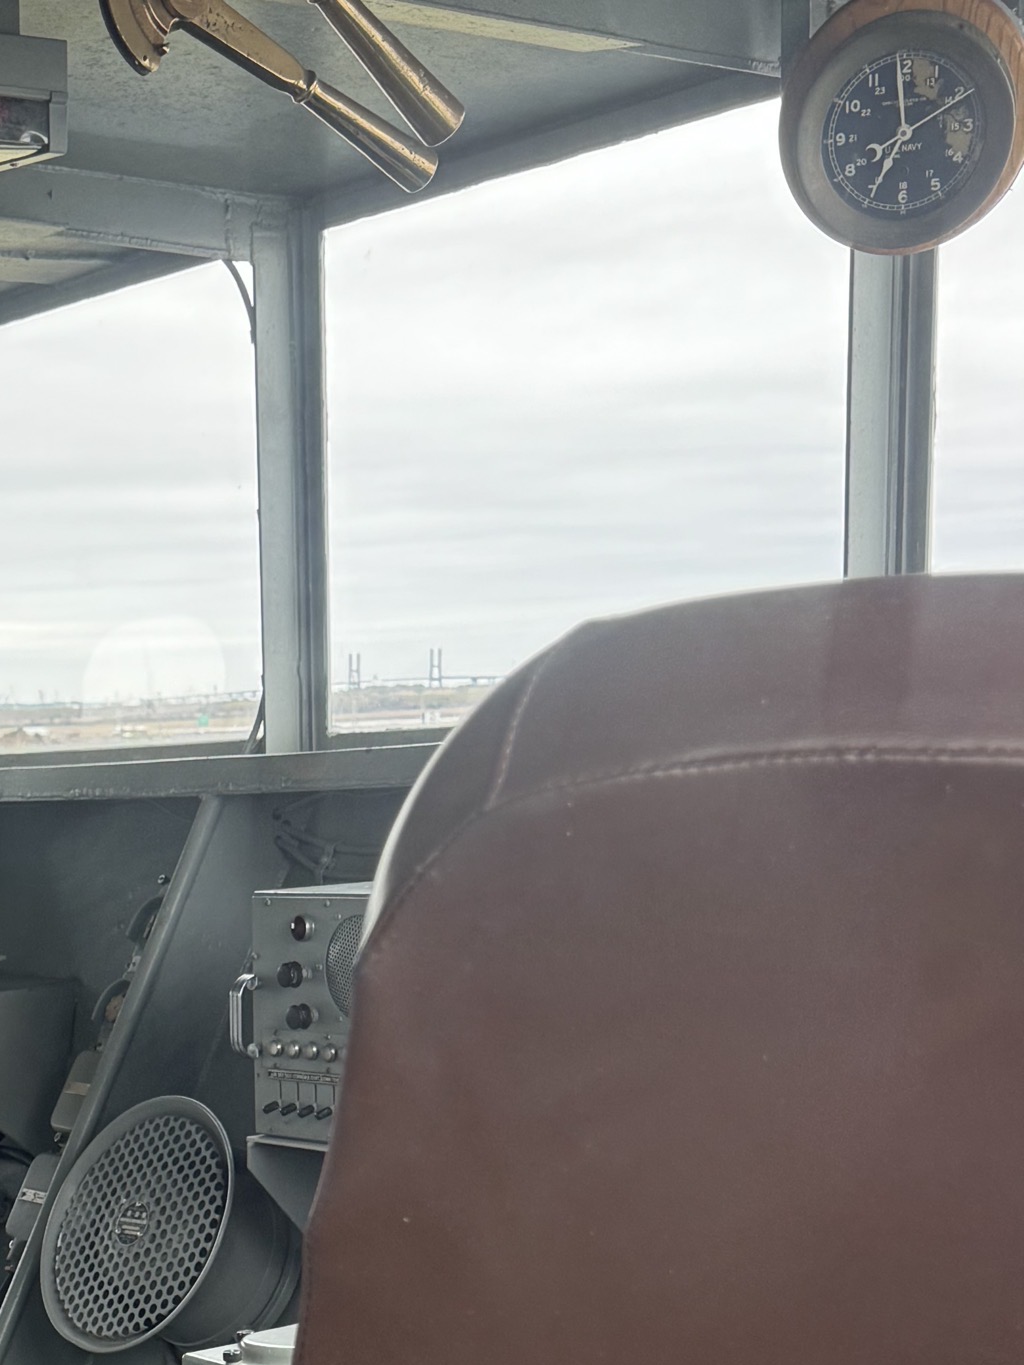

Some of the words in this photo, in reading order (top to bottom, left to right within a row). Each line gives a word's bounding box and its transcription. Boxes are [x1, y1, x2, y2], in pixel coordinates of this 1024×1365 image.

[868, 73, 879, 88] 11
[926, 78, 935, 86] 13
[874, 87, 886, 95] 23
[954, 86, 965, 99] 2
[845, 99, 860, 114] 10
[861, 109, 871, 117] 22
[951, 122, 960, 131] 15
[963, 118, 973, 132] 3
[836, 132, 845, 146] 9
[848, 134, 857, 143] 21
[901, 142, 922, 152] NAVY
[945, 149, 954, 157] 16
[952, 151, 964, 164] 4
[856, 158, 867, 166] 20
[845, 163, 856, 177] 8
[925, 169, 934, 178] 17
[899, 181, 907, 189] 18
[930, 177, 941, 191] 5
[898, 189, 908, 203] 6
